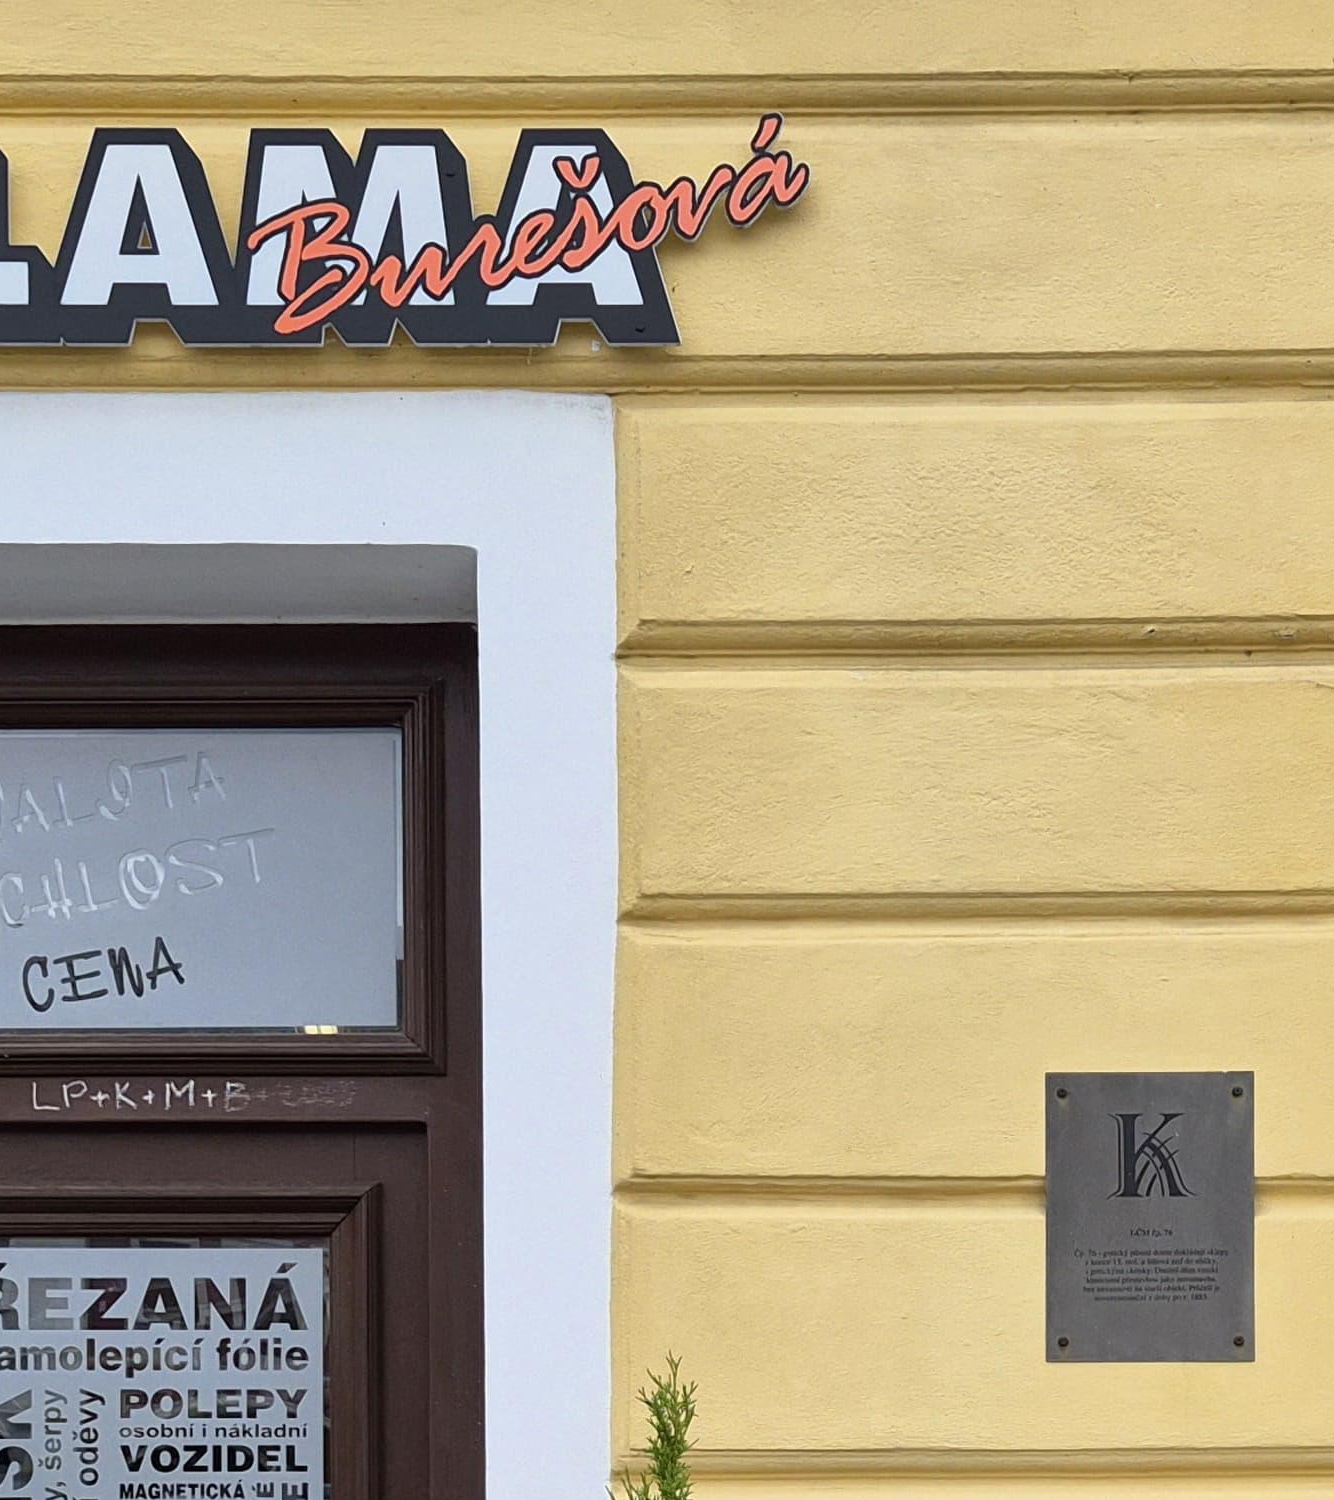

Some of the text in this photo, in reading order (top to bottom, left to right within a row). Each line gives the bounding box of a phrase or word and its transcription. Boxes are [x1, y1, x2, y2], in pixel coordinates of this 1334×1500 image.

[251, 115, 809, 334] Burešová
[21, 936, 186, 1013] CENA
[216, 1338, 310, 1371] fólie
[119, 1388, 308, 1420] POLEPY
[37, 1389, 67, 1471] šerpy
[72, 1389, 106, 1486] oděvy
[119, 1421, 308, 1438] osobní i nákladní
[119, 1445, 309, 1472] VOZIDEL
[120, 1479, 245, 1500] MAGNETICKÁ
